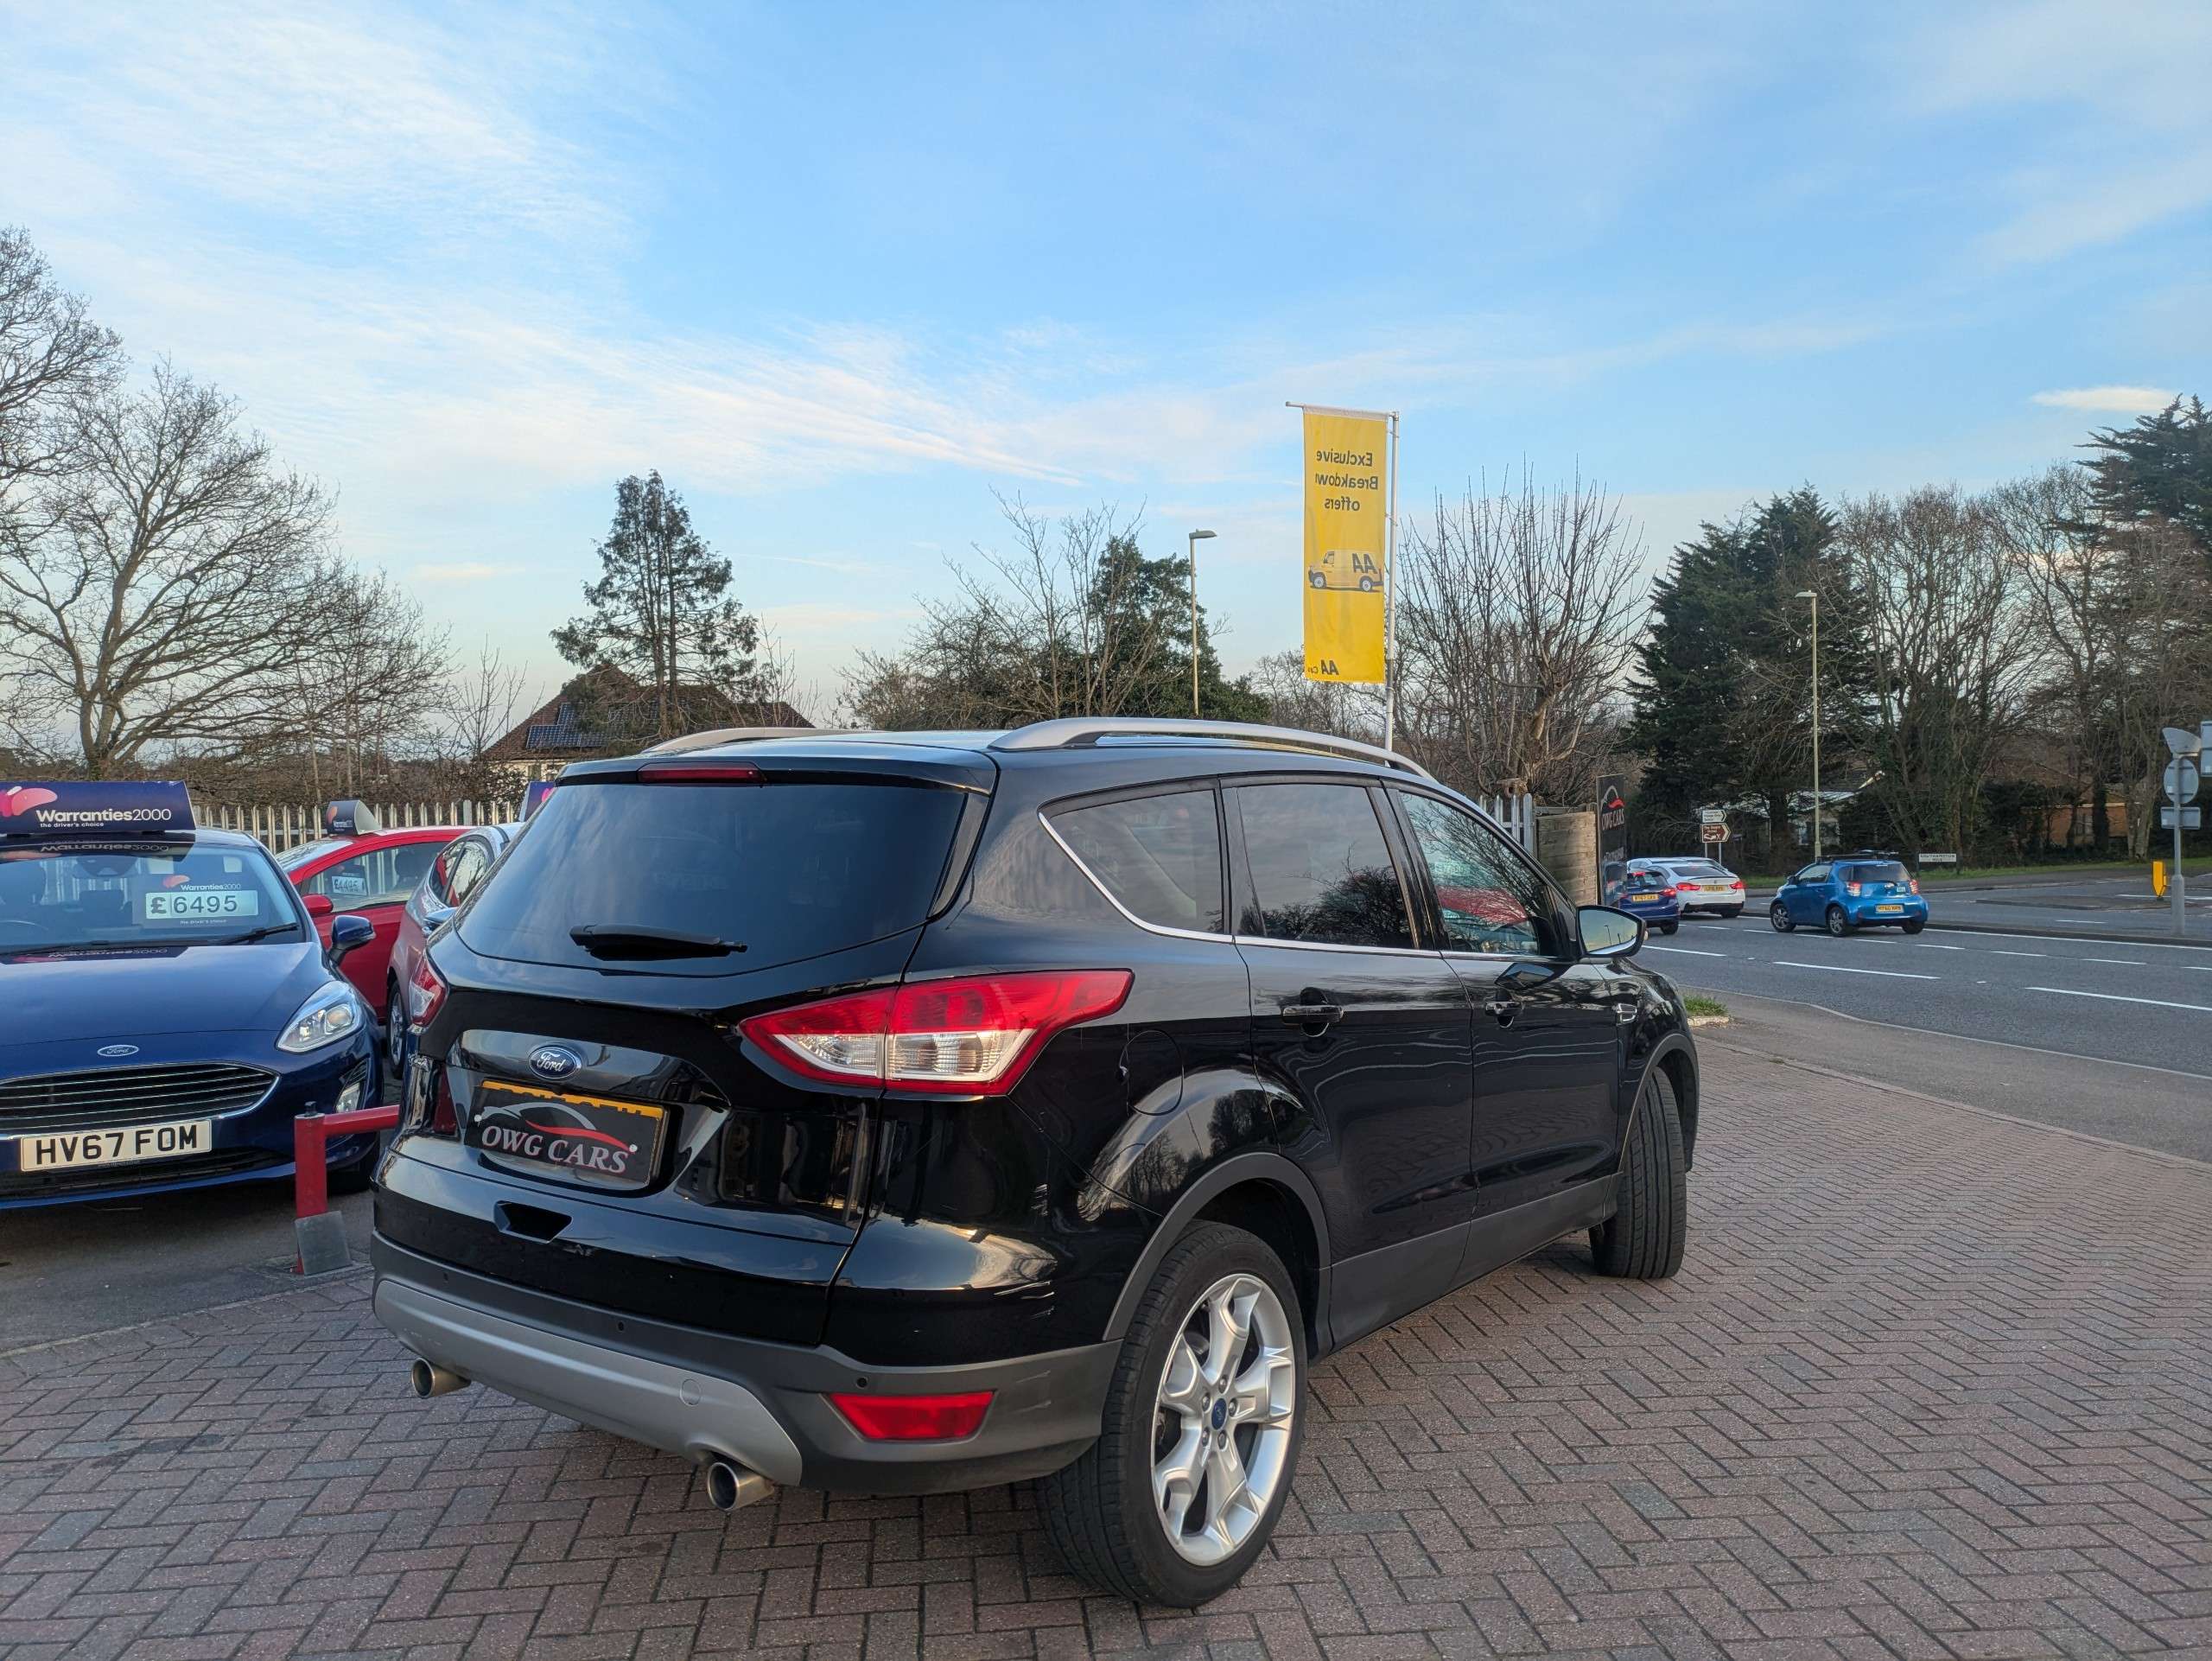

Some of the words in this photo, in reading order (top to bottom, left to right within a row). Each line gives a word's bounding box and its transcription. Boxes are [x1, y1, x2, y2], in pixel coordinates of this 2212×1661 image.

[35, 809, 172, 822] Warranties2000
[1613, 808, 1624, 826] CARS
[106, 1046, 130, 1055] Ford
[536, 1051, 566, 1072] Ford
[35, 1132, 124, 1165] HV67
[135, 1124, 197, 1155] FOM
[481, 1125, 543, 1156] OWG
[548, 1139, 629, 1174] CARS
